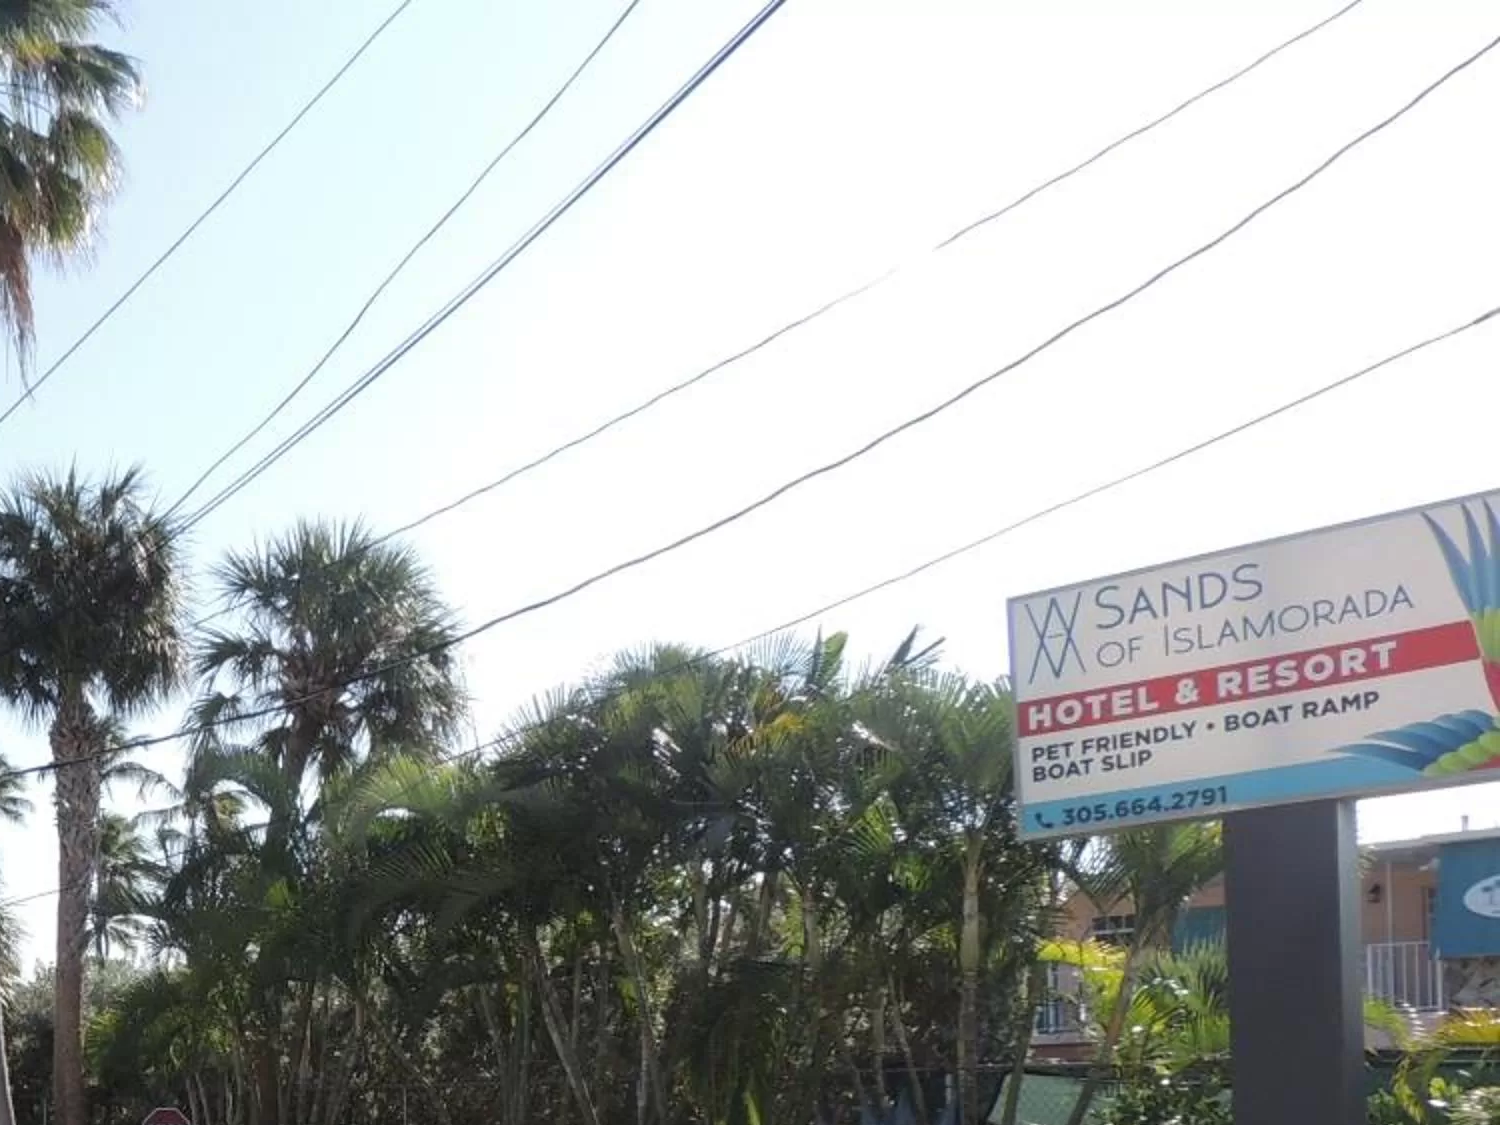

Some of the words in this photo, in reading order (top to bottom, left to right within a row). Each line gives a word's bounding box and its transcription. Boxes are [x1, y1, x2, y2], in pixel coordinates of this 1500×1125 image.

[1095, 563, 1263, 630] SANDS
[1097, 636, 1143, 668] OF
[1164, 585, 1415, 657] ISLAMORADA
[1028, 685, 1159, 730] HOTEL
[1174, 679, 1199, 704] &
[1217, 641, 1398, 698] RESORT
[1032, 742, 1074, 763] PET
[1081, 721, 1197, 755] FRIENDLY
[1224, 705, 1293, 732] BOAT
[1302, 691, 1380, 719] RAMP
[1032, 760, 1093, 782] BOAT
[1101, 750, 1153, 772] SLIP
[1061, 785, 1227, 826] 305.664.2791
